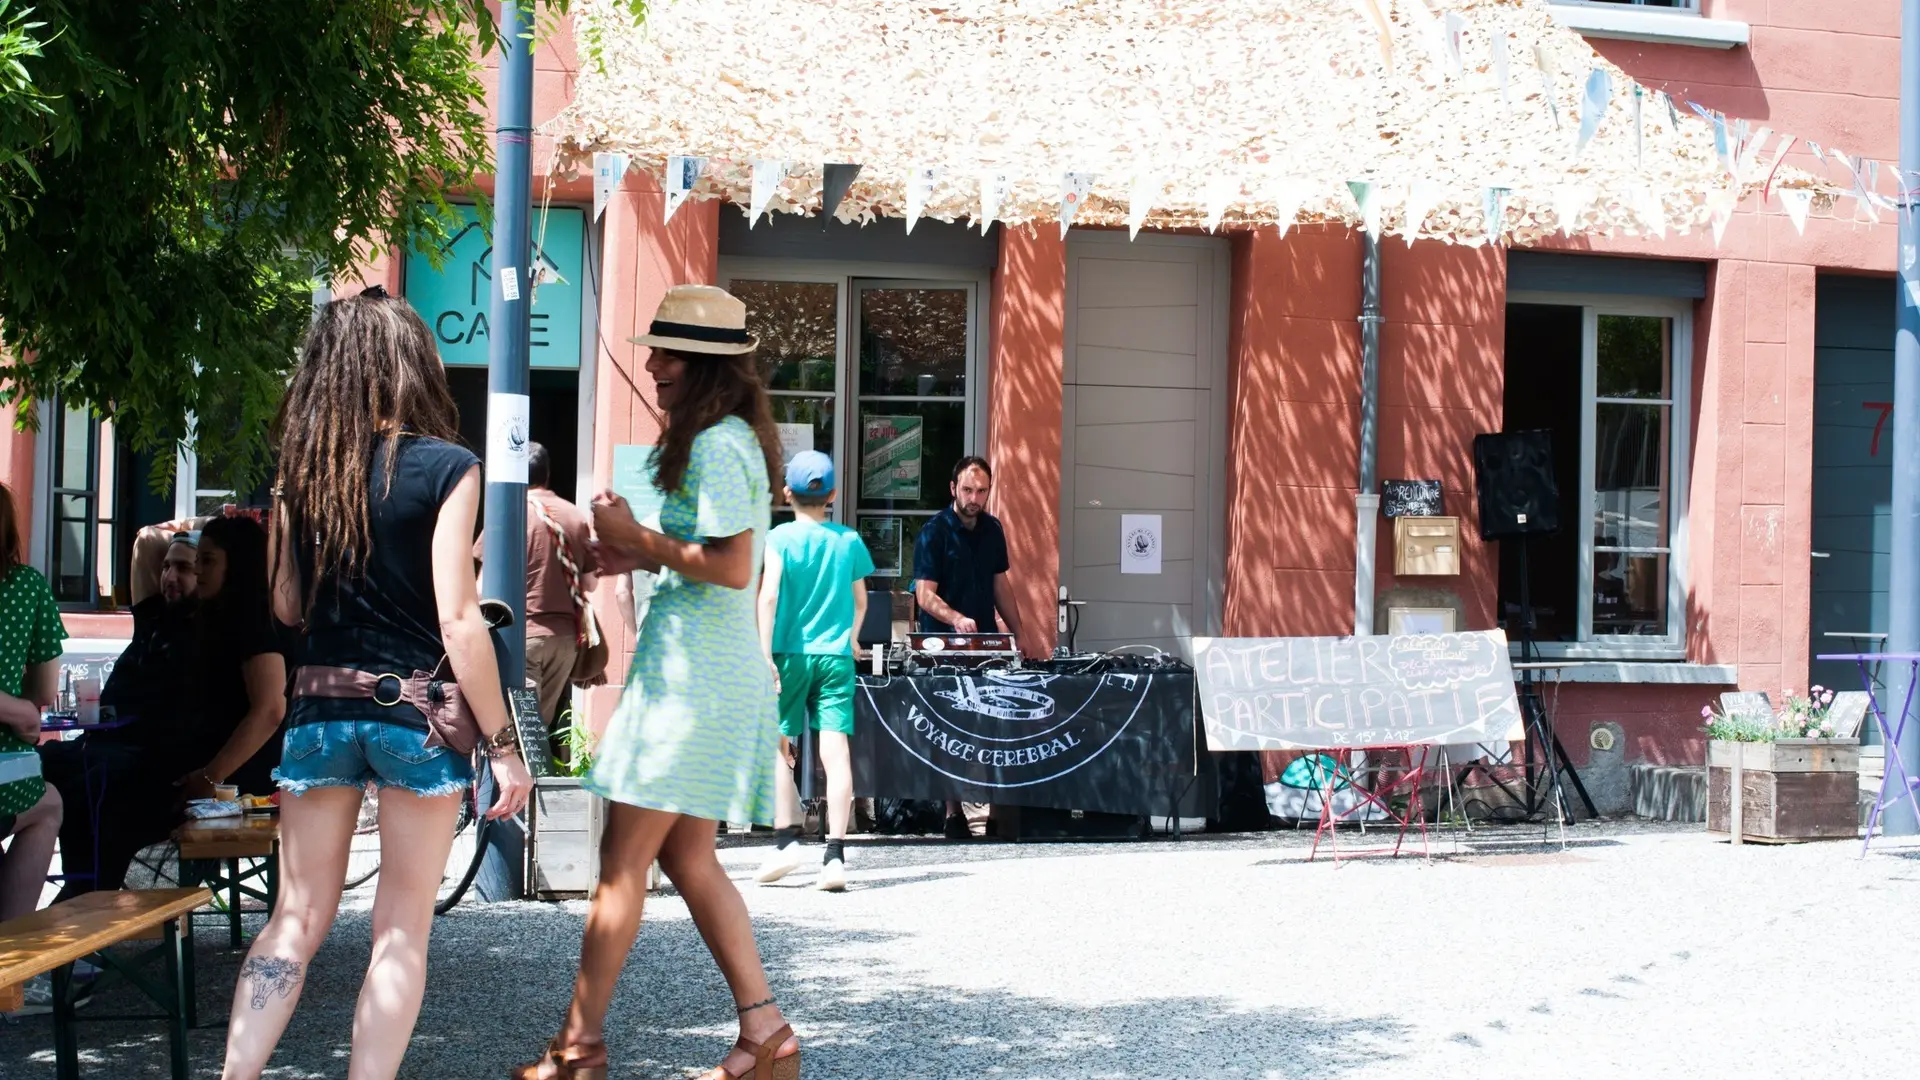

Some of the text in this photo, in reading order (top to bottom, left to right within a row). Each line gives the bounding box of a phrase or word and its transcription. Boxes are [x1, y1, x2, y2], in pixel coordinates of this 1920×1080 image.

[436, 311, 550, 346] CAE
[1862, 401, 1894, 457] 7
[1206, 637, 1396, 688] ATELIER
[1213, 682, 1503, 732] PARTICIPATIF
[906, 704, 976, 762] VOYAGE
[977, 731, 1081, 767] CEREBRAL
[1331, 731, 1351, 744] DE
